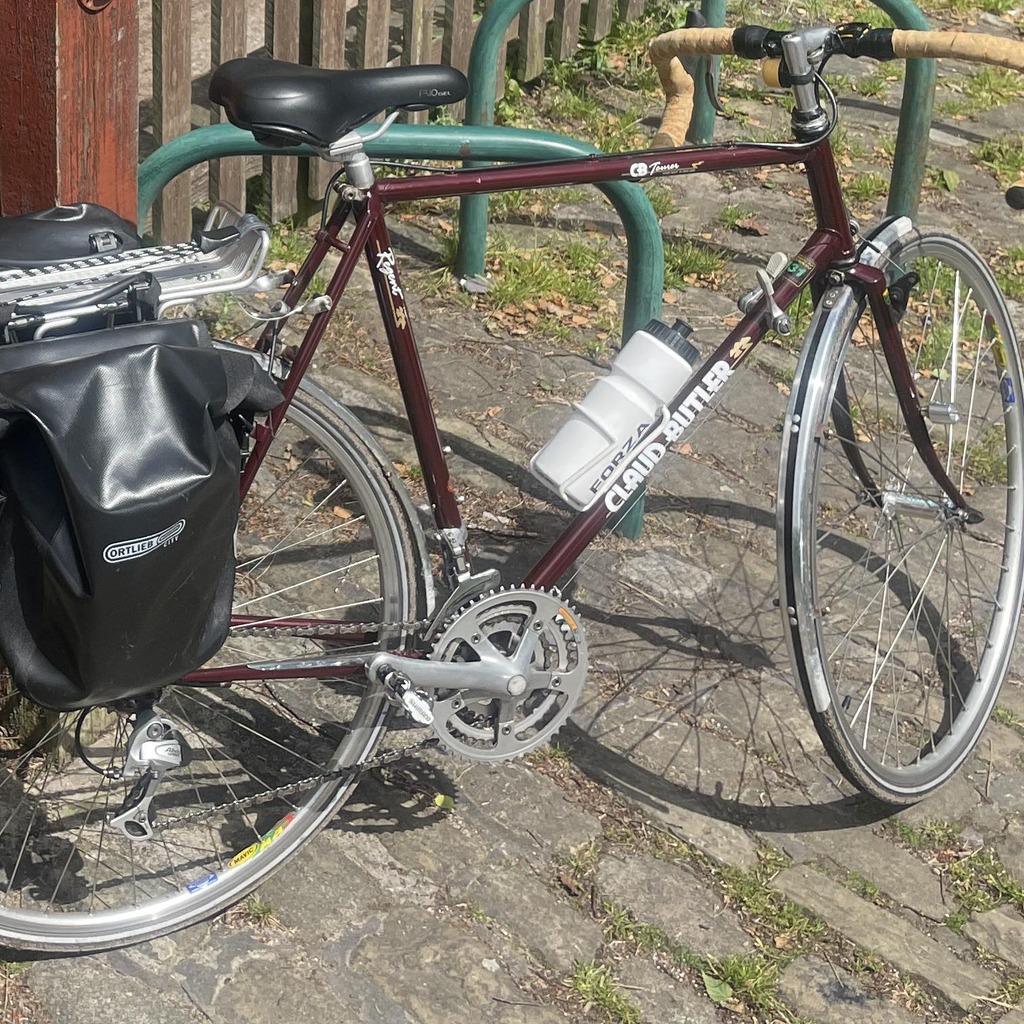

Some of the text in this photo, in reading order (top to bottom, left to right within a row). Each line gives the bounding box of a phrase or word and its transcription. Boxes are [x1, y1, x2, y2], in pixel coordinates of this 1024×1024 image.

[376, 247, 404, 300] Regent
[589, 423, 652, 495] FORZA
[604, 360, 736, 513] CLAUD BUTLER
[109, 540, 154, 558] ORTLIEB
[233, 846, 255, 865] MAVIC
